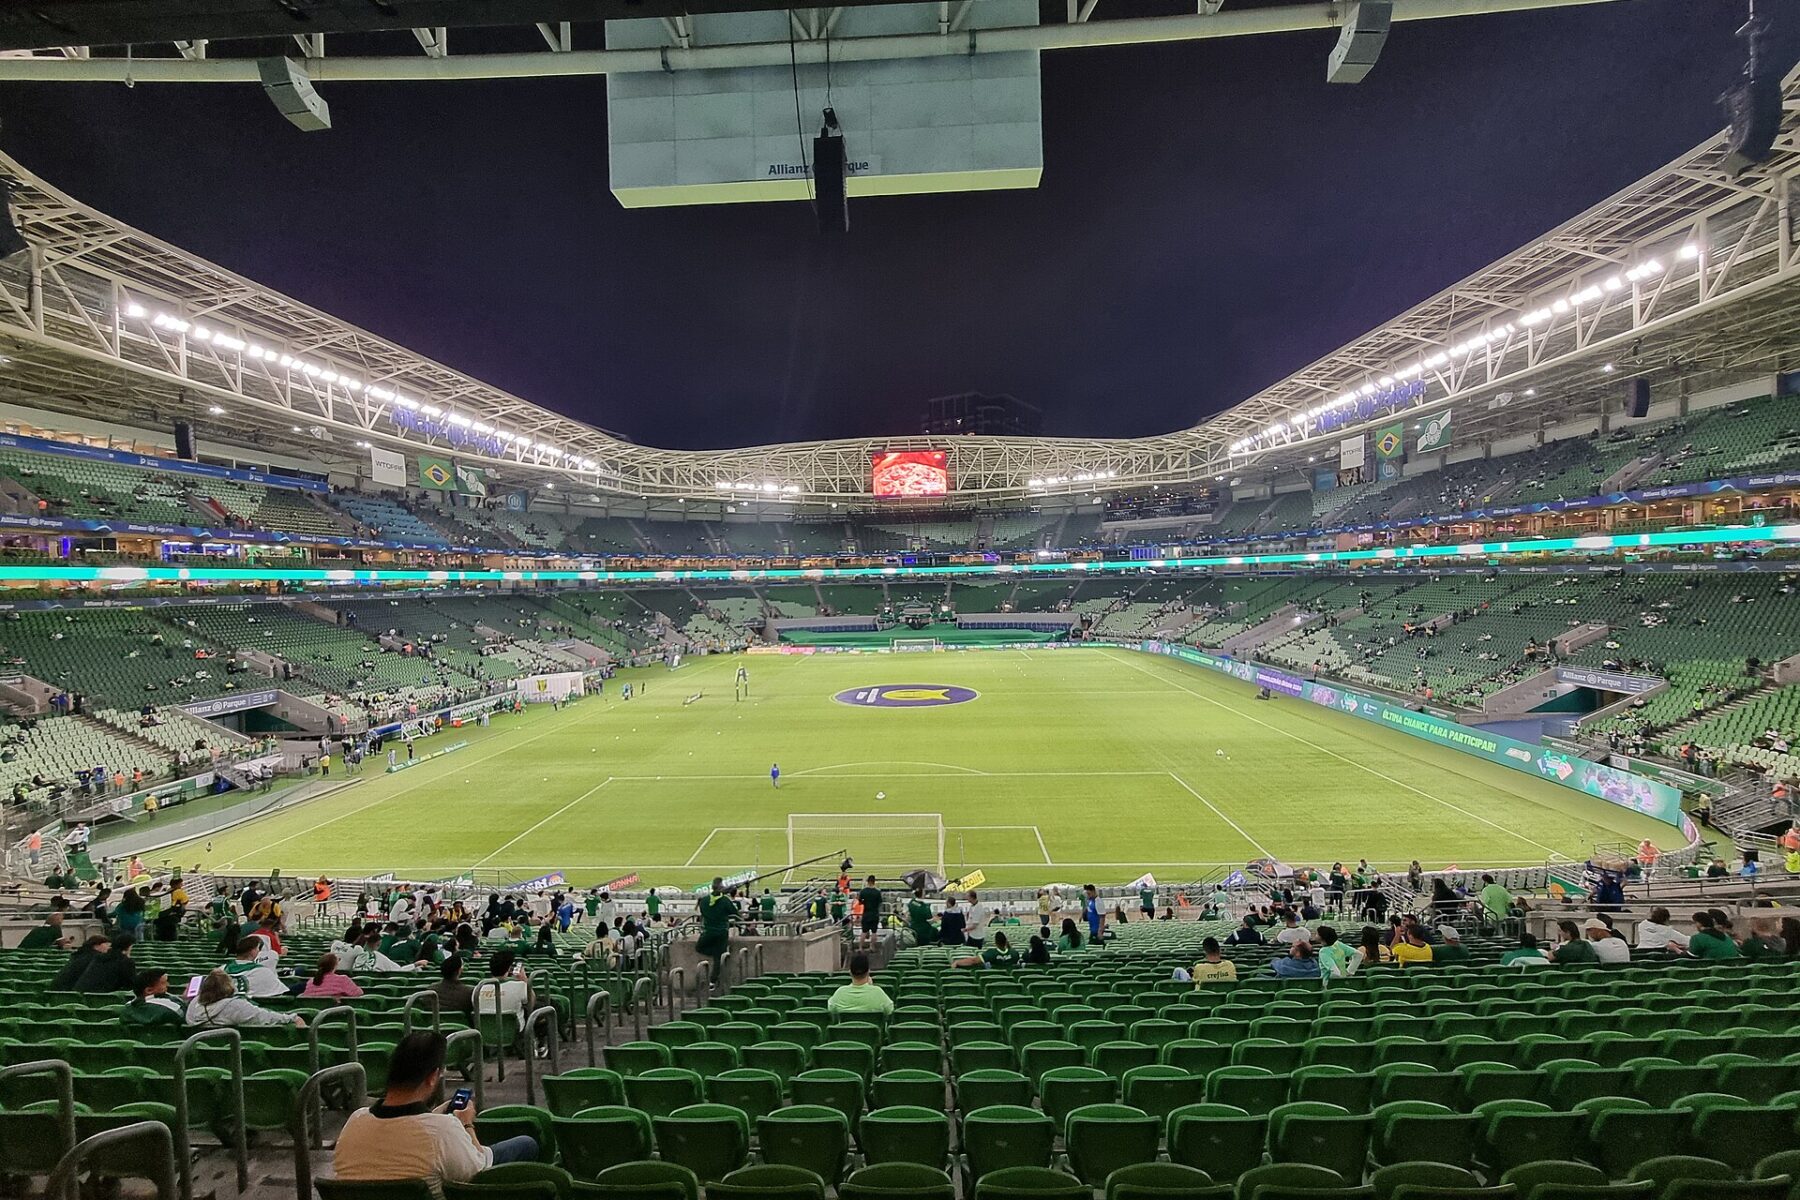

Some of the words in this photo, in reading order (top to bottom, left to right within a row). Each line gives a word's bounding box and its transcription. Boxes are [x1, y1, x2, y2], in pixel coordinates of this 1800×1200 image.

[768, 164, 809, 175] Allianz
[1562, 671, 1587, 682] Allianz
[1597, 676, 1622, 687] Parque
[222, 699, 247, 709] Parque
[1382, 708, 1403, 724] ÚLTIMA
[1403, 717, 1429, 732] CHANCE
[1429, 725, 1448, 738] PARA
[1448, 730, 1497, 753] PARTICIPAR!
